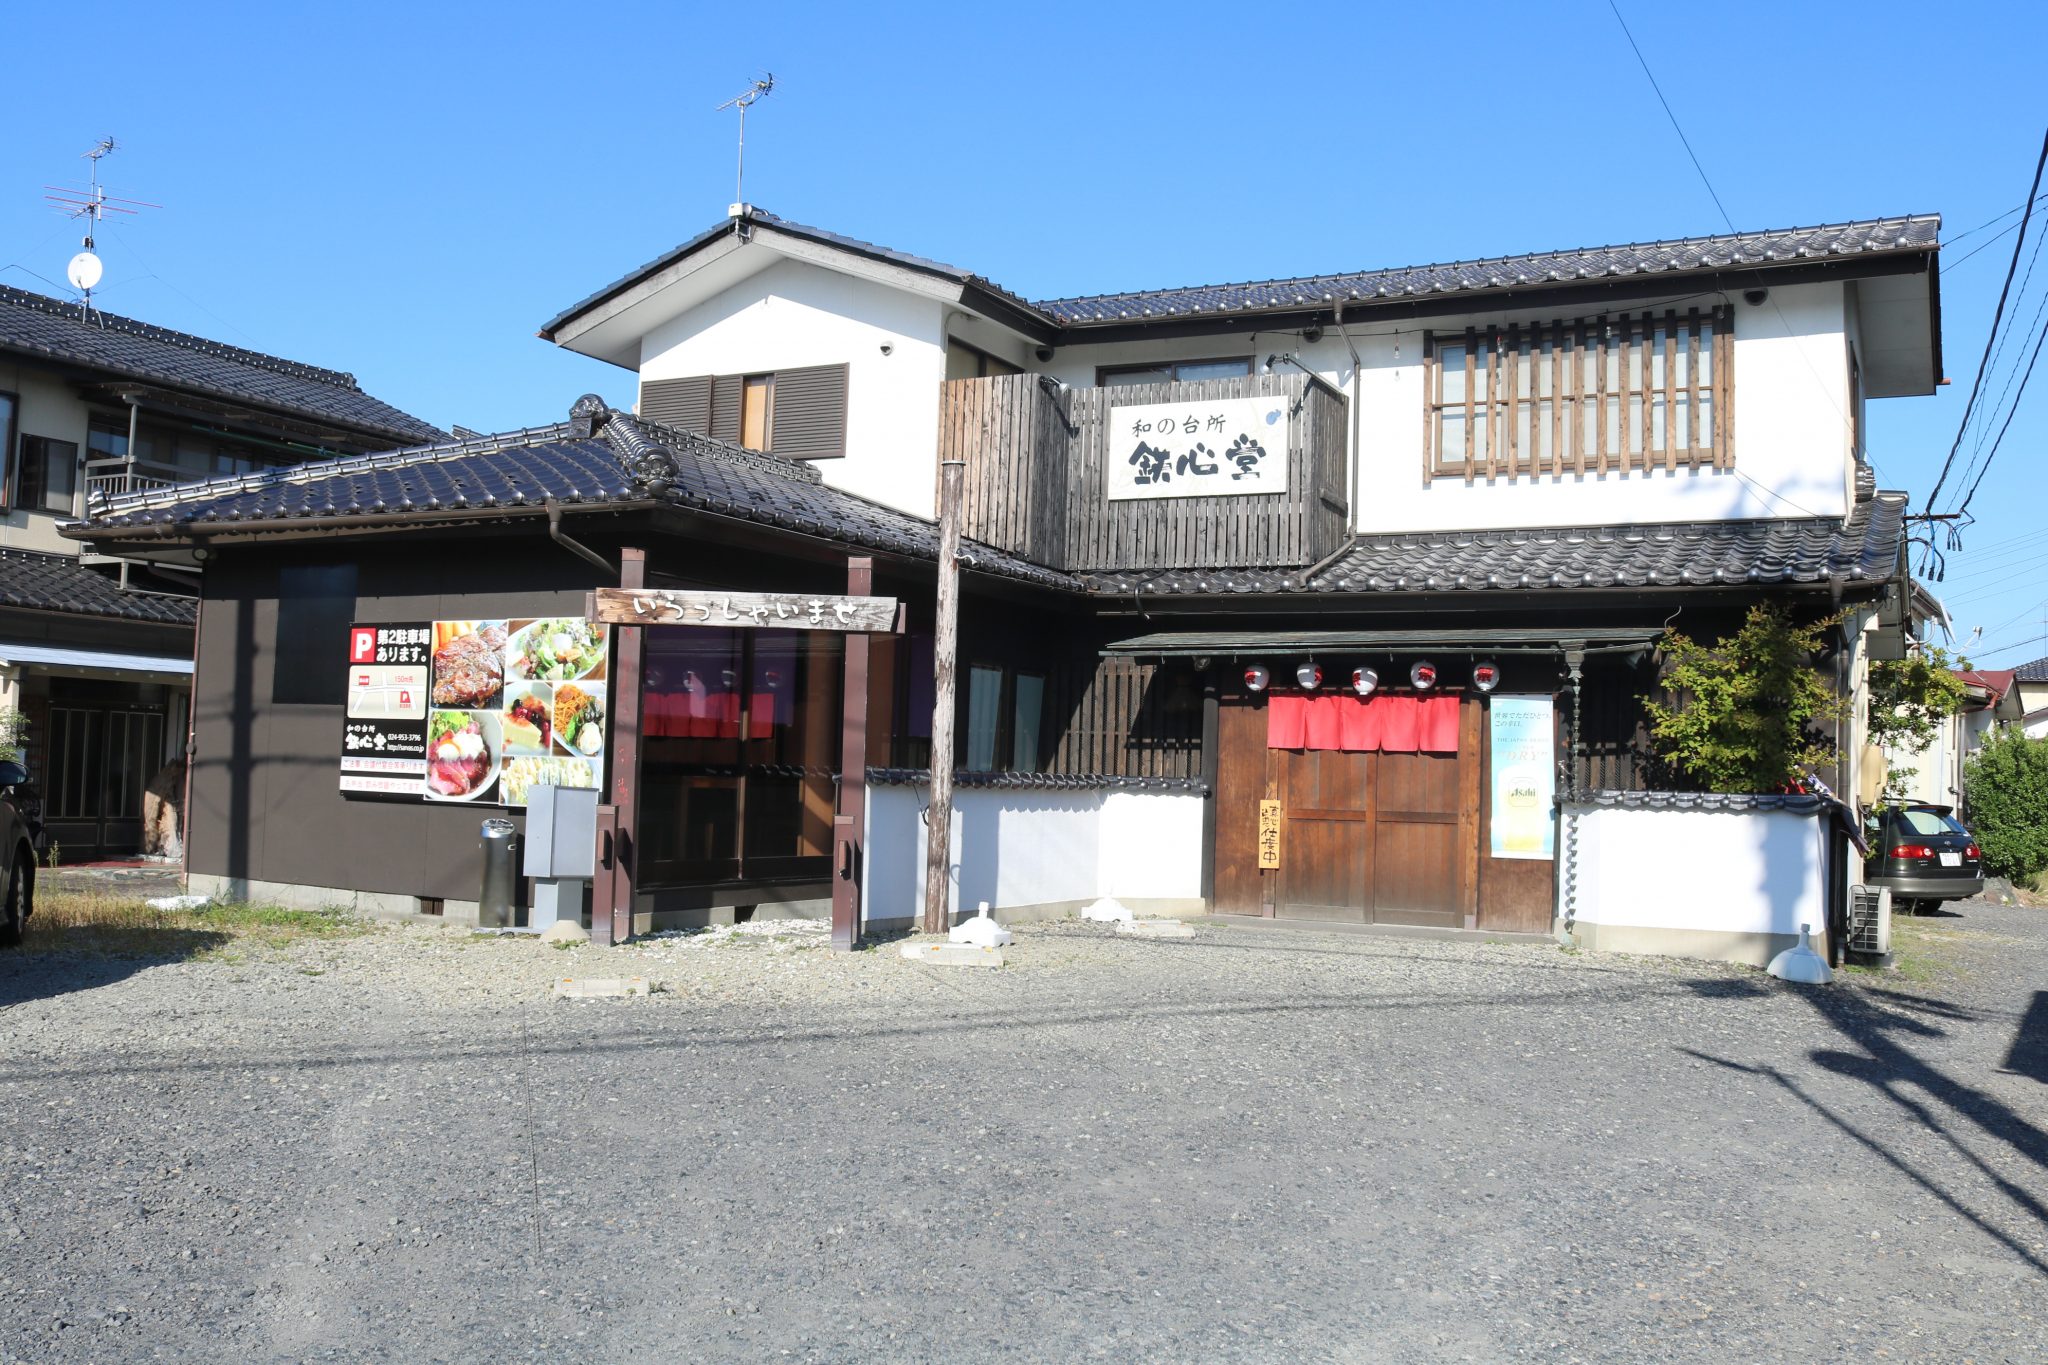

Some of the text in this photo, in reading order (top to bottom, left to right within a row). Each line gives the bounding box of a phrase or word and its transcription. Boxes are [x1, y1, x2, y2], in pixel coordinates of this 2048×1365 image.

[1132, 414, 1226, 438] 和の台所
[633, 594, 858, 625] いらっしゃいませ
[377, 629, 430, 645] 第2駐車場
[355, 633, 372, 660] P
[376, 646, 427, 662] あります。
[346, 724, 376, 733] 和の台所
[1510, 787, 1536, 798] Asahi
